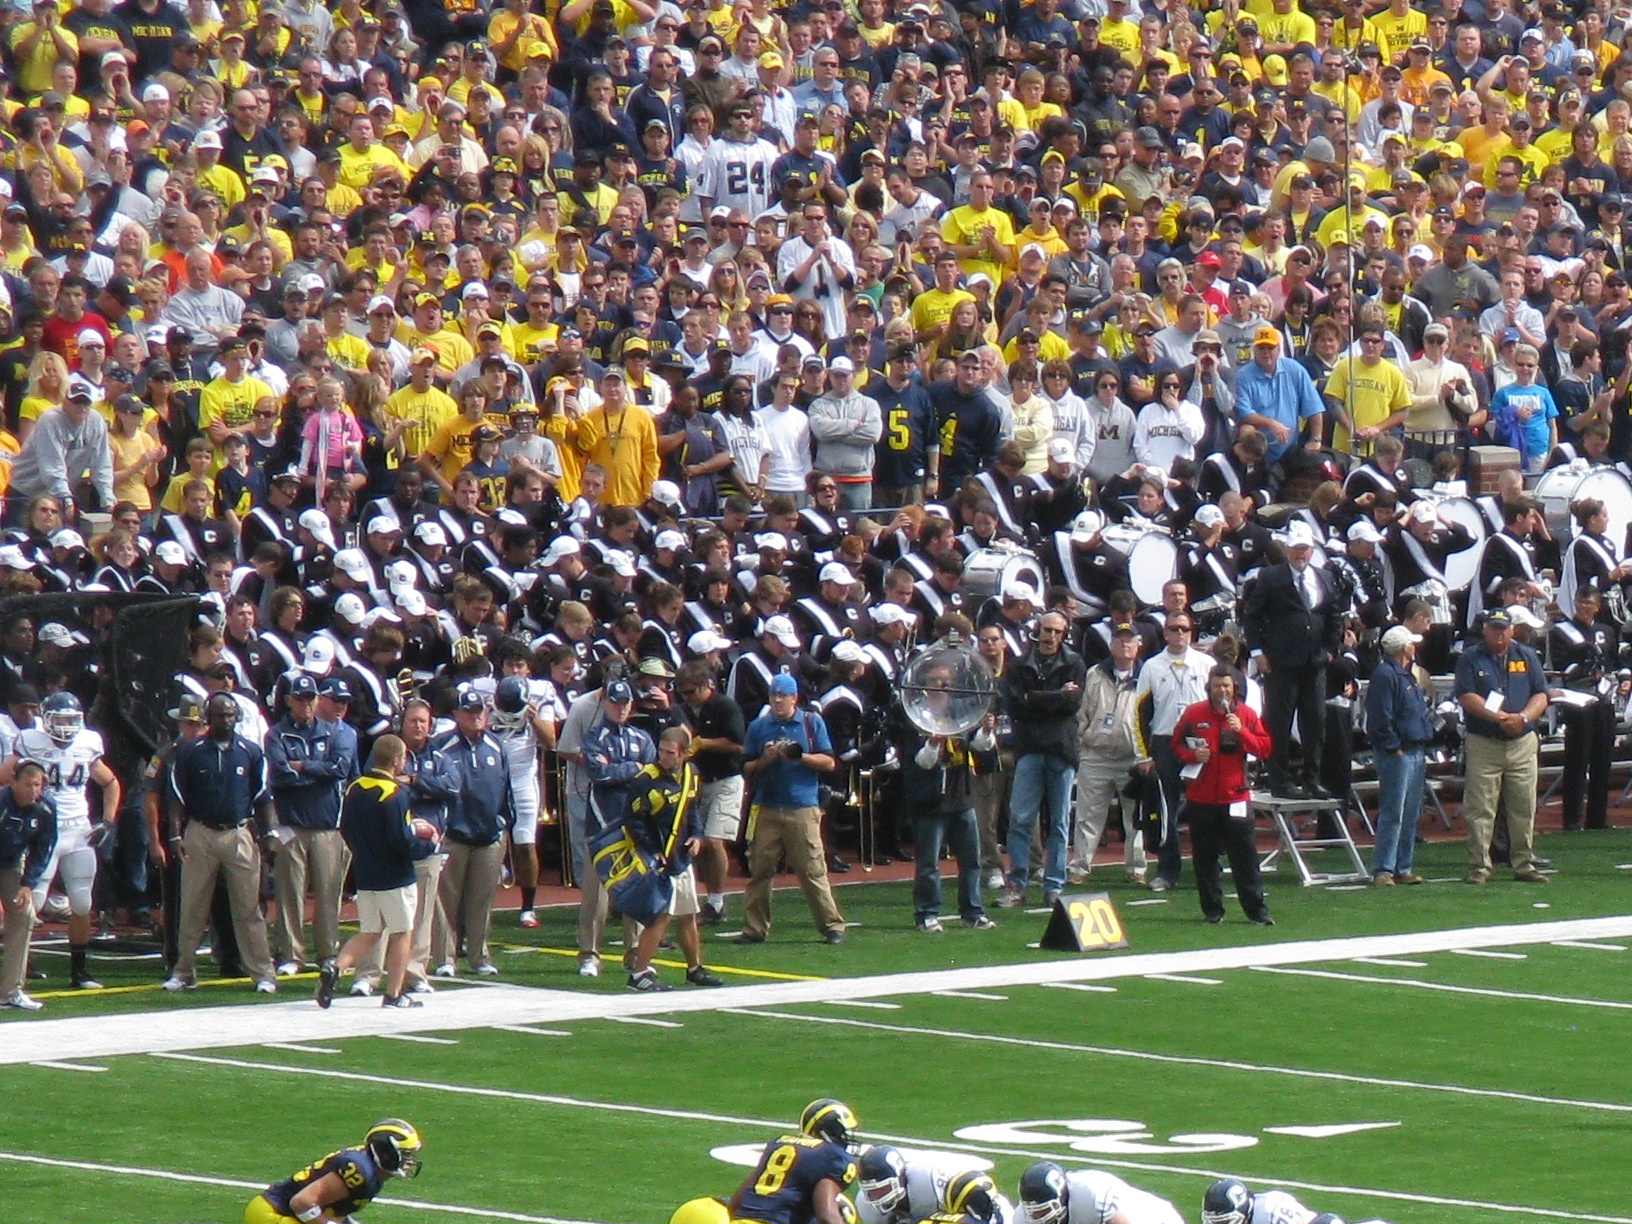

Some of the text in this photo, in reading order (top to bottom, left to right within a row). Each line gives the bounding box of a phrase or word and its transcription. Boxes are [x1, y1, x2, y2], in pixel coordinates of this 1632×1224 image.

[727, 161, 768, 195] 24
[421, 231, 434, 241] M
[442, 309, 453, 319] M
[14, 362, 32, 382] M
[889, 410, 910, 451] 5
[939, 416, 958, 457] 4
[1099, 425, 1120, 440] M
[1014, 485, 1023, 498] C
[473, 521, 485, 534] C
[837, 517, 848, 529] C
[204, 530, 217, 543] C
[1242, 539, 1253, 551] C
[439, 563, 453, 574] C
[580, 589, 592, 601] C
[951, 593, 962, 605] C
[846, 608, 859, 620] C
[1494, 611, 1504, 619] M
[250, 652, 260, 666] C
[1509, 661, 1526, 672] M
[49, 763, 87, 793] 44
[1069, 898, 1125, 948] 20
[337, 1161, 365, 1191] 32
[752, 1144, 798, 1197] 8
[841, 1161, 858, 1185] 8
